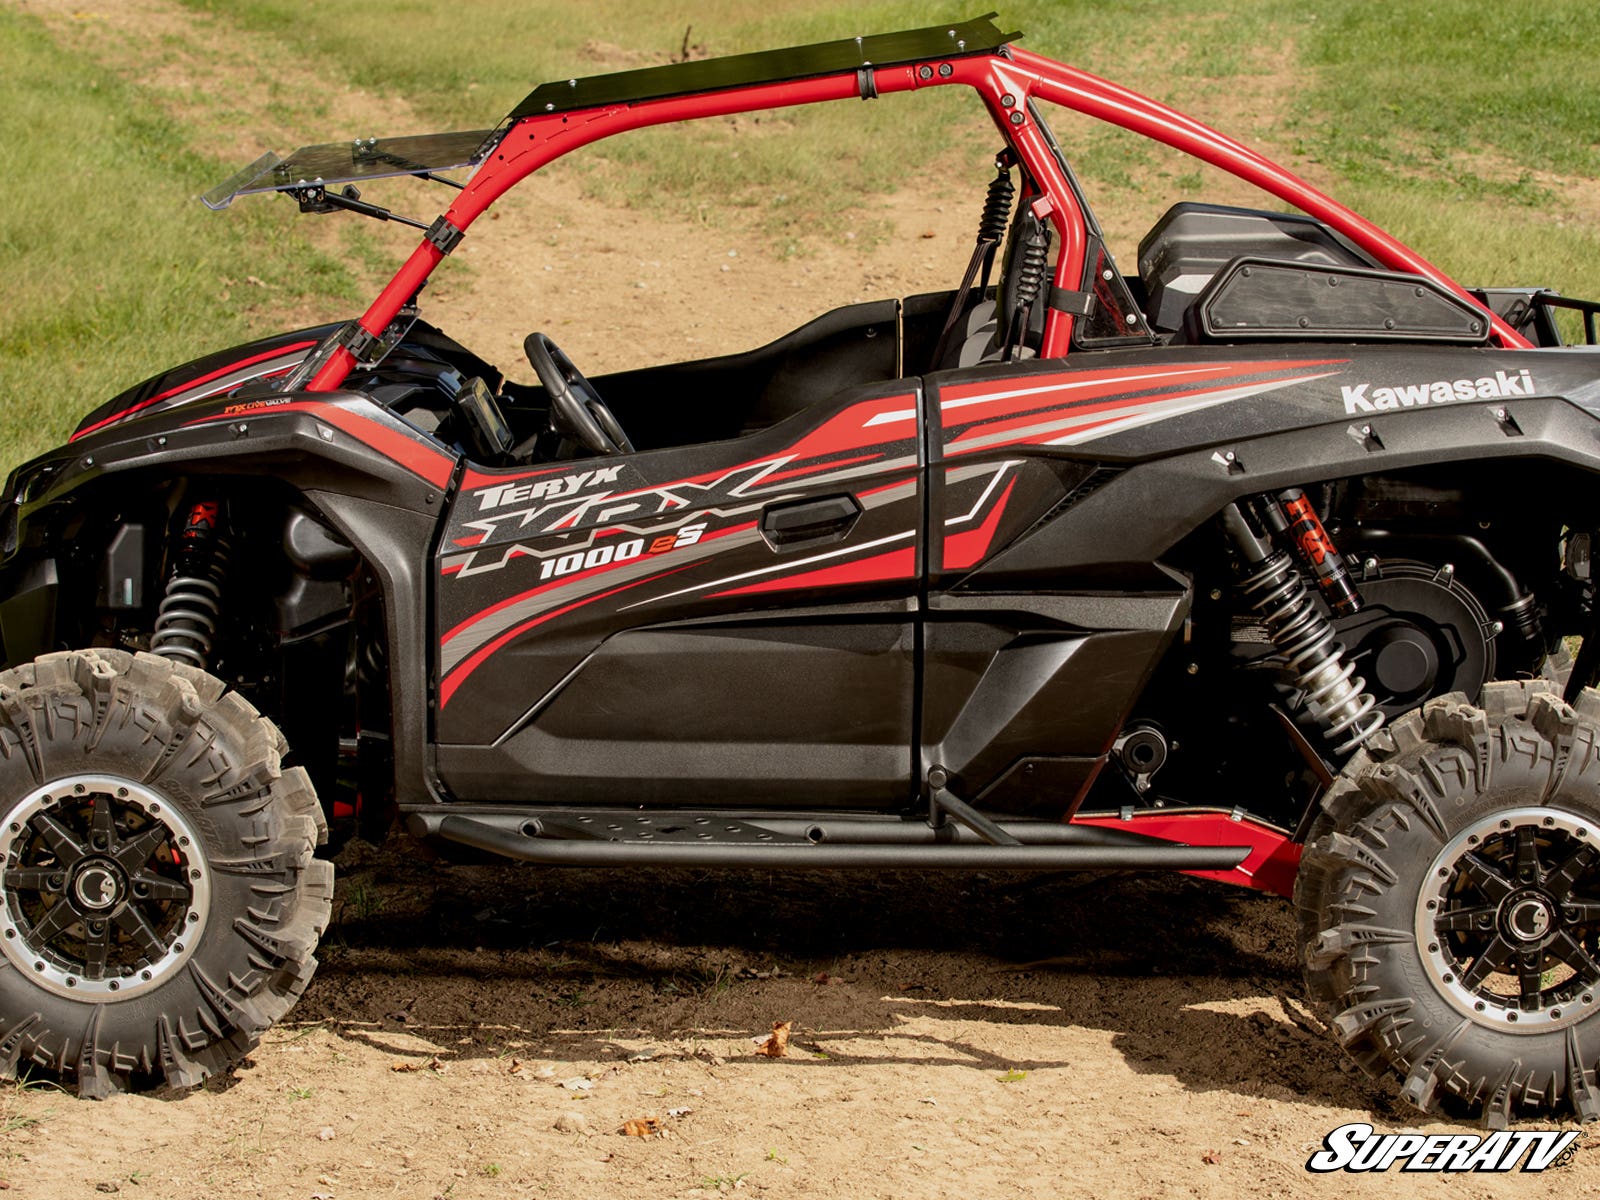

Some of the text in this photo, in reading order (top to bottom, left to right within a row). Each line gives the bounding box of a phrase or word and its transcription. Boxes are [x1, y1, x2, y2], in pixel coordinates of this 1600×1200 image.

[1340, 369, 1536, 414] Kawasaki
[473, 464, 626, 511] TERYX
[539, 538, 645, 580] 1000
